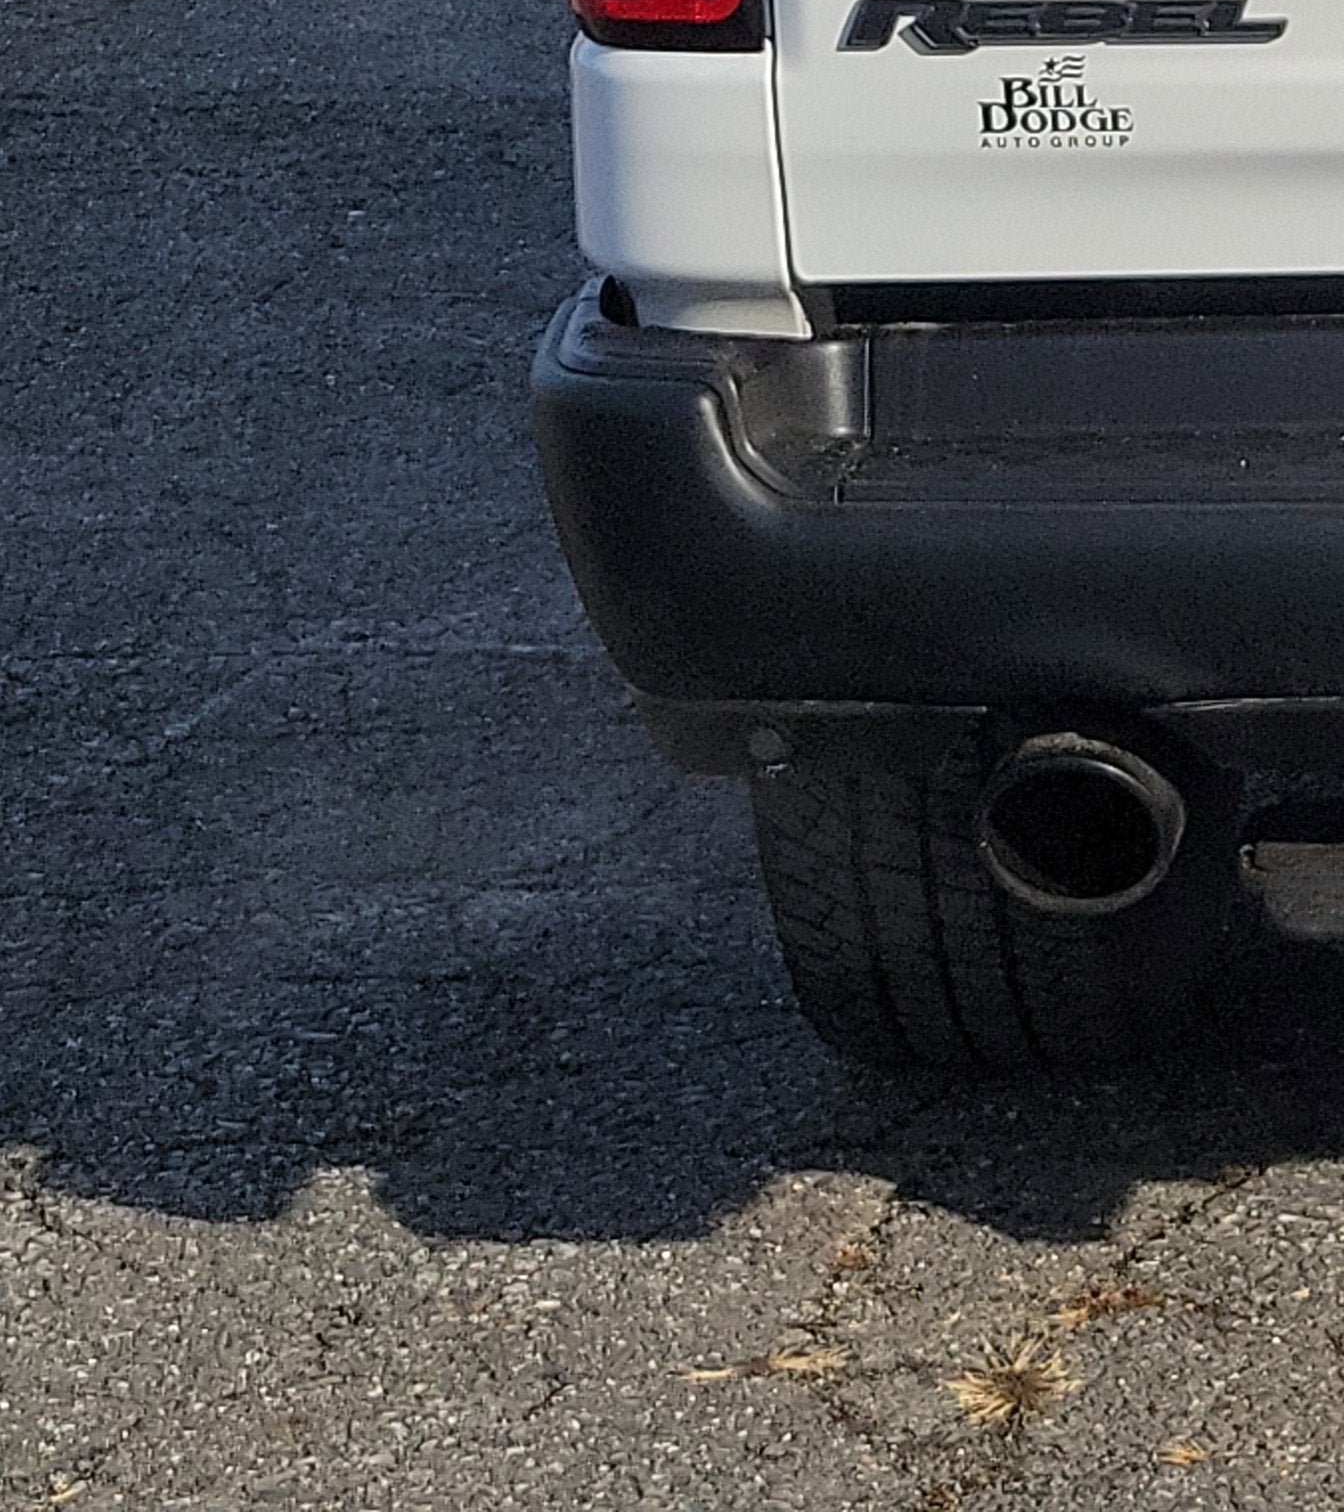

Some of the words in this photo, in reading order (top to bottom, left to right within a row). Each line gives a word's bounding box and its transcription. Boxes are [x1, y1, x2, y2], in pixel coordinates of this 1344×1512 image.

[998, 76, 1099, 109] BILL
[977, 101, 1135, 134] DODGE
[980, 136, 1041, 149] AUTO
[1050, 134, 1130, 149] GROUP
